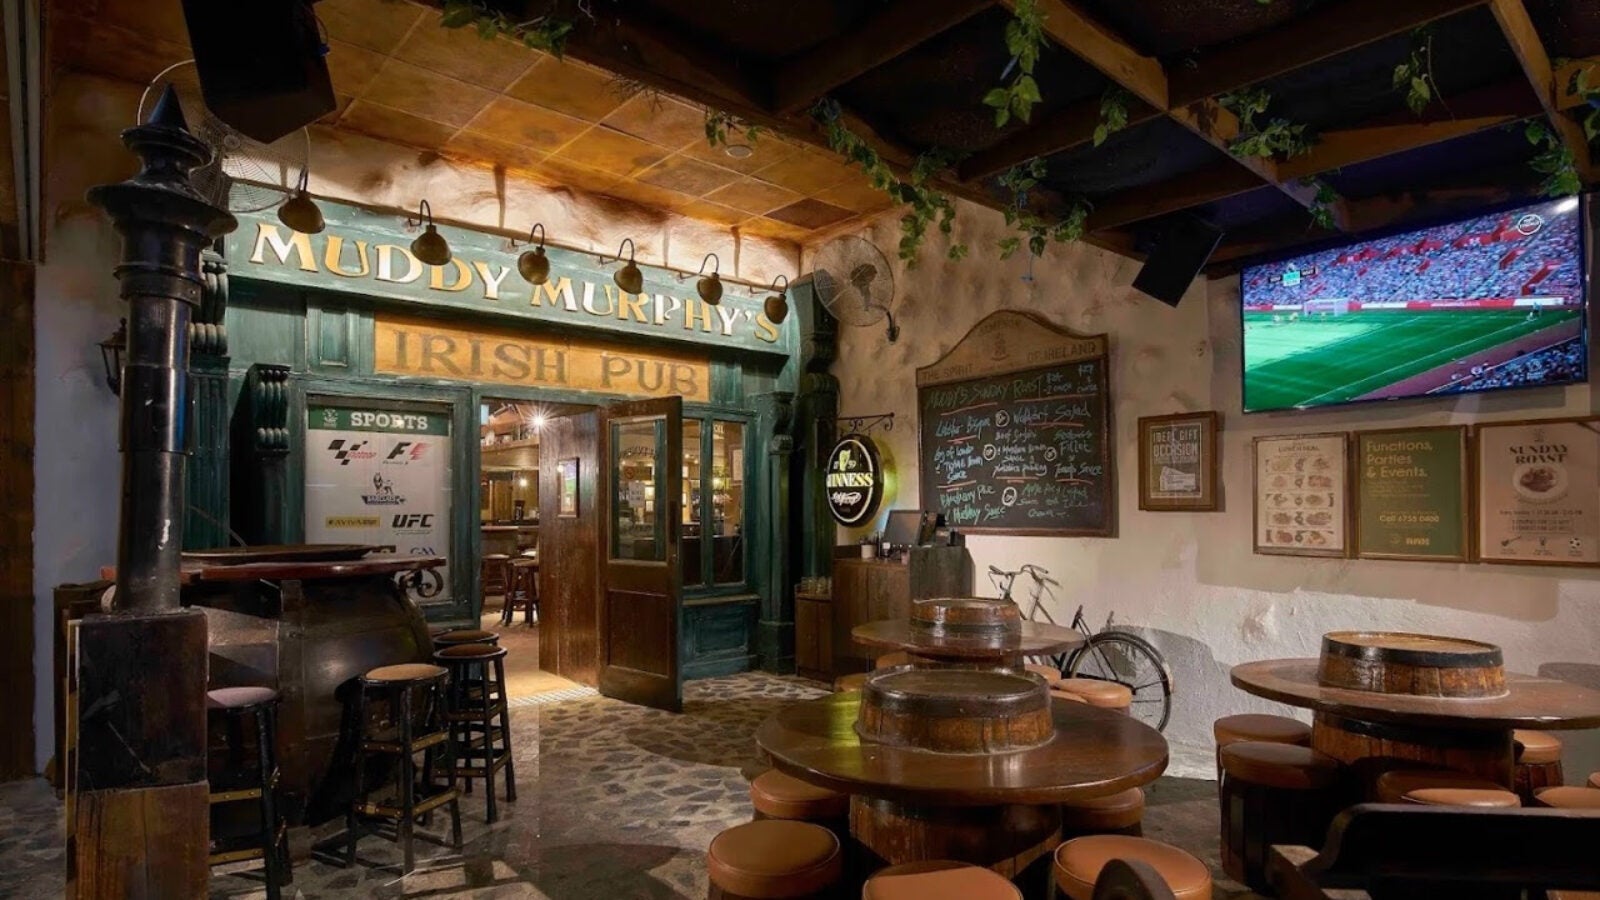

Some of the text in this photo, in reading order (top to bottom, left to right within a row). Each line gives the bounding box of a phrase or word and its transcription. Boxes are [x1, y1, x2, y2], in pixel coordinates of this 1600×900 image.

[249, 222, 780, 343] MUDDY MURPHY'S
[393, 329, 700, 396] IRISH PUB
[350, 411, 428, 430] SPORTS
[1179, 428, 1198, 441] GIFT
[1509, 444, 1568, 455] SUNDAY
[1366, 454, 1413, 465] Parties
[1515, 454, 1566, 464] ROAST
[392, 513, 435, 529] UFC
[1379, 514, 1396, 522] Call
